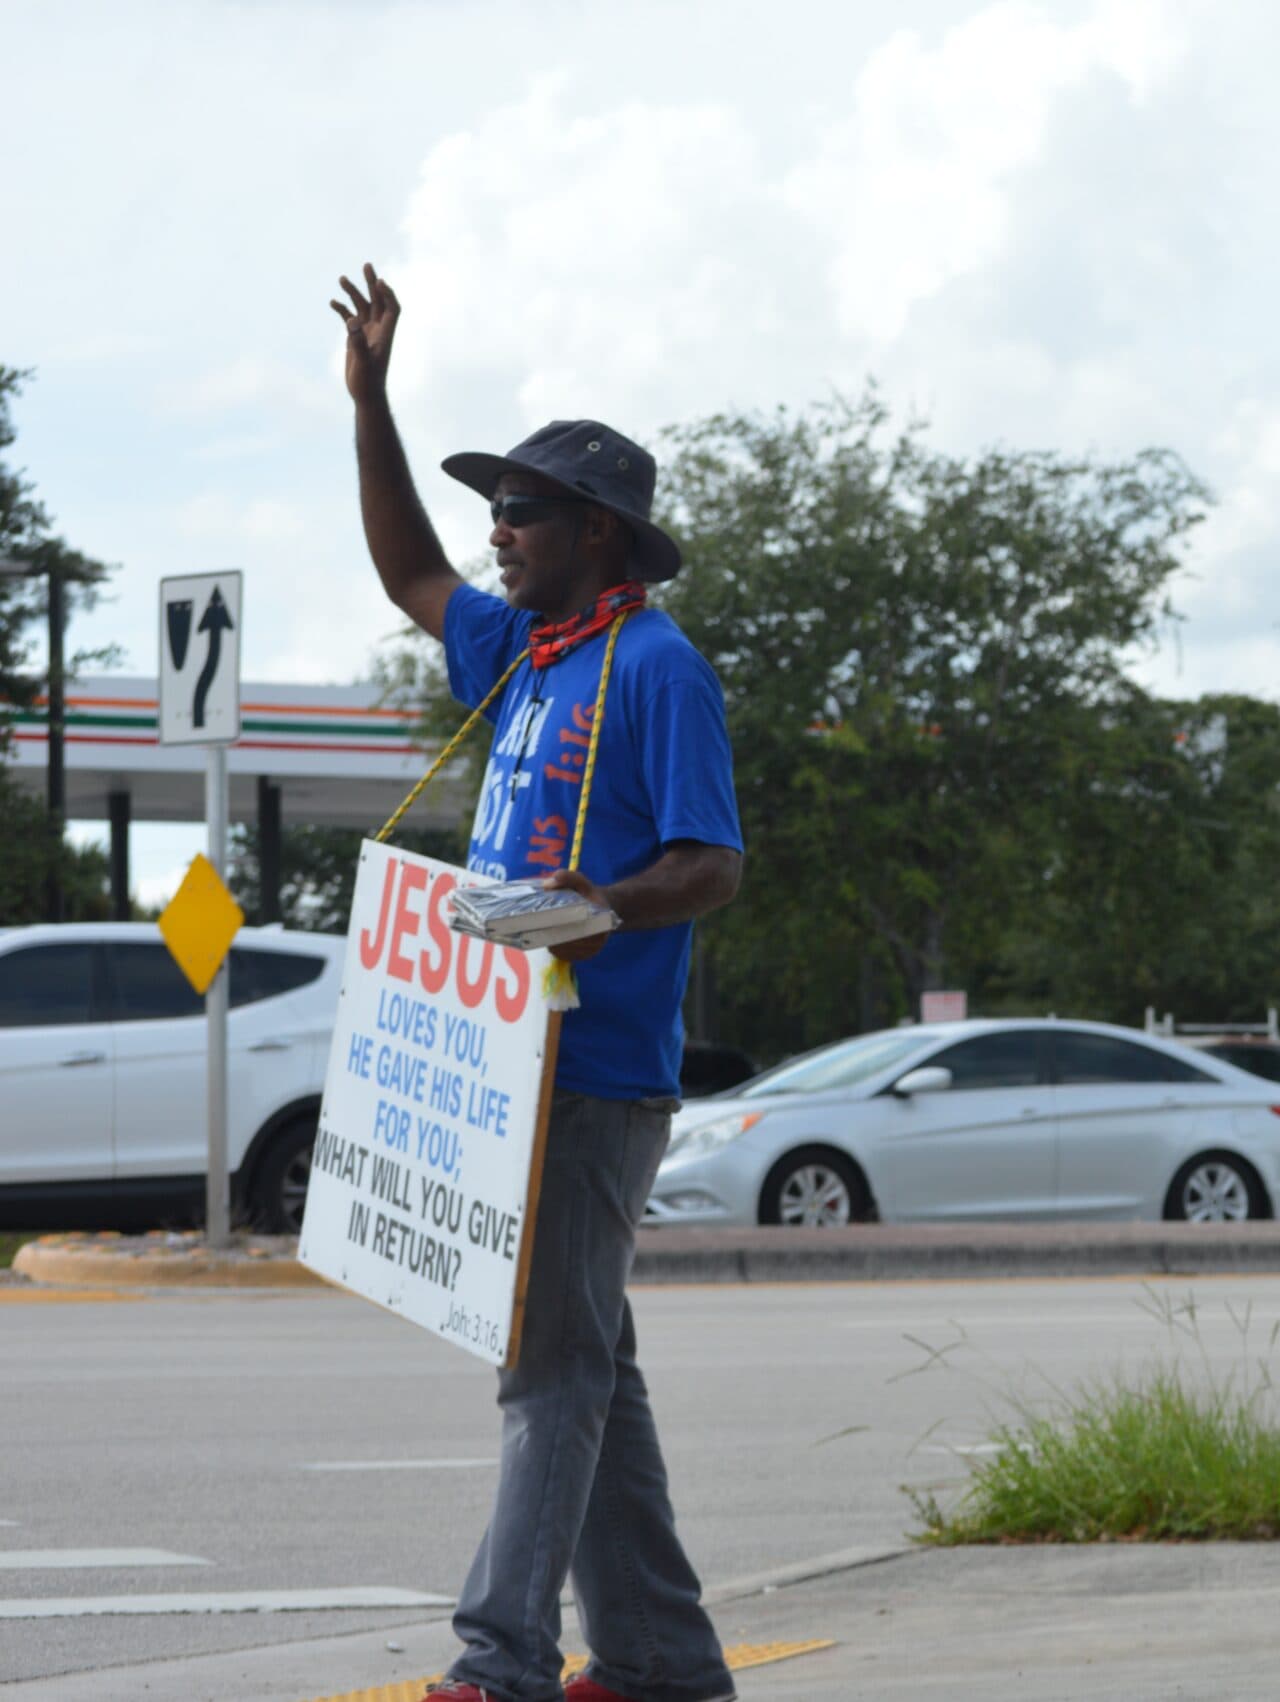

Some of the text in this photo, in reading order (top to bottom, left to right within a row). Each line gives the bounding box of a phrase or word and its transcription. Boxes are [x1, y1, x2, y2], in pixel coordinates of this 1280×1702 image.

[377, 988, 488, 1077] LOVES YOU,
[348, 1032, 510, 1138] HE GAVE HIS LIFE
[374, 1100, 463, 1183] FOR YOU;
[314, 1127, 518, 1261] WHAT WILL YOU GIVE
[348, 1200, 462, 1292] IN RETURN?
[472, 1314, 499, 1352] 3:16
